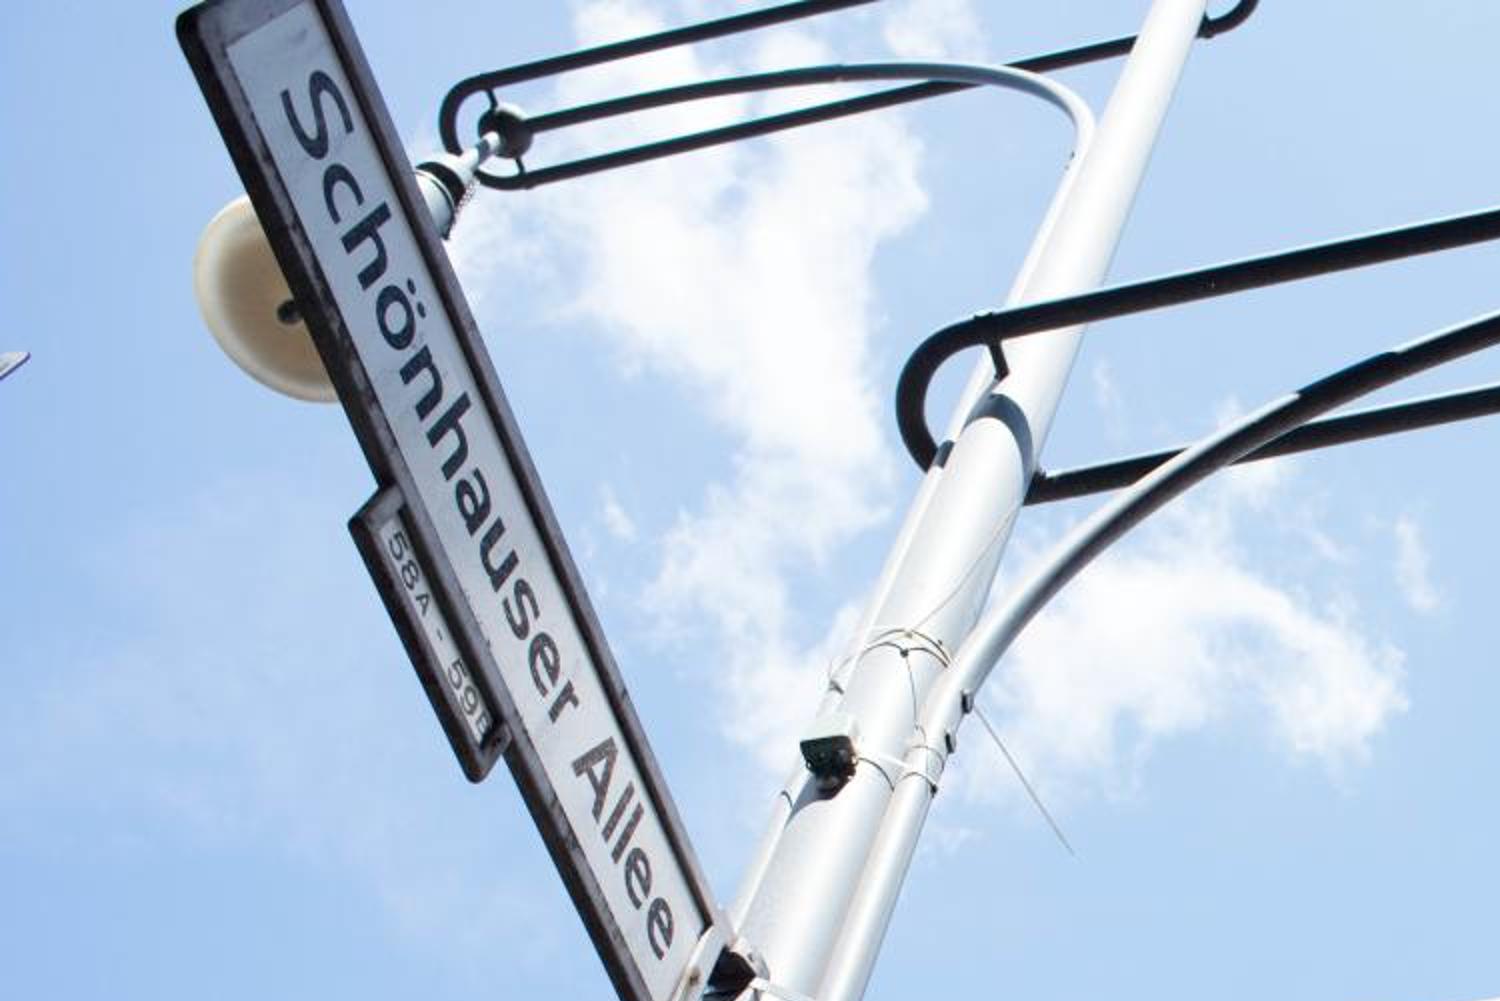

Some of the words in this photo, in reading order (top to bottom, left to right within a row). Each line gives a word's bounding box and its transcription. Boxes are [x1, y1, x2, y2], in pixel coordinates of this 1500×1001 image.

[281, 68, 581, 723] Schönhauser
[572, 737, 675, 961] Allee
[388, 531, 434, 617] 58A
